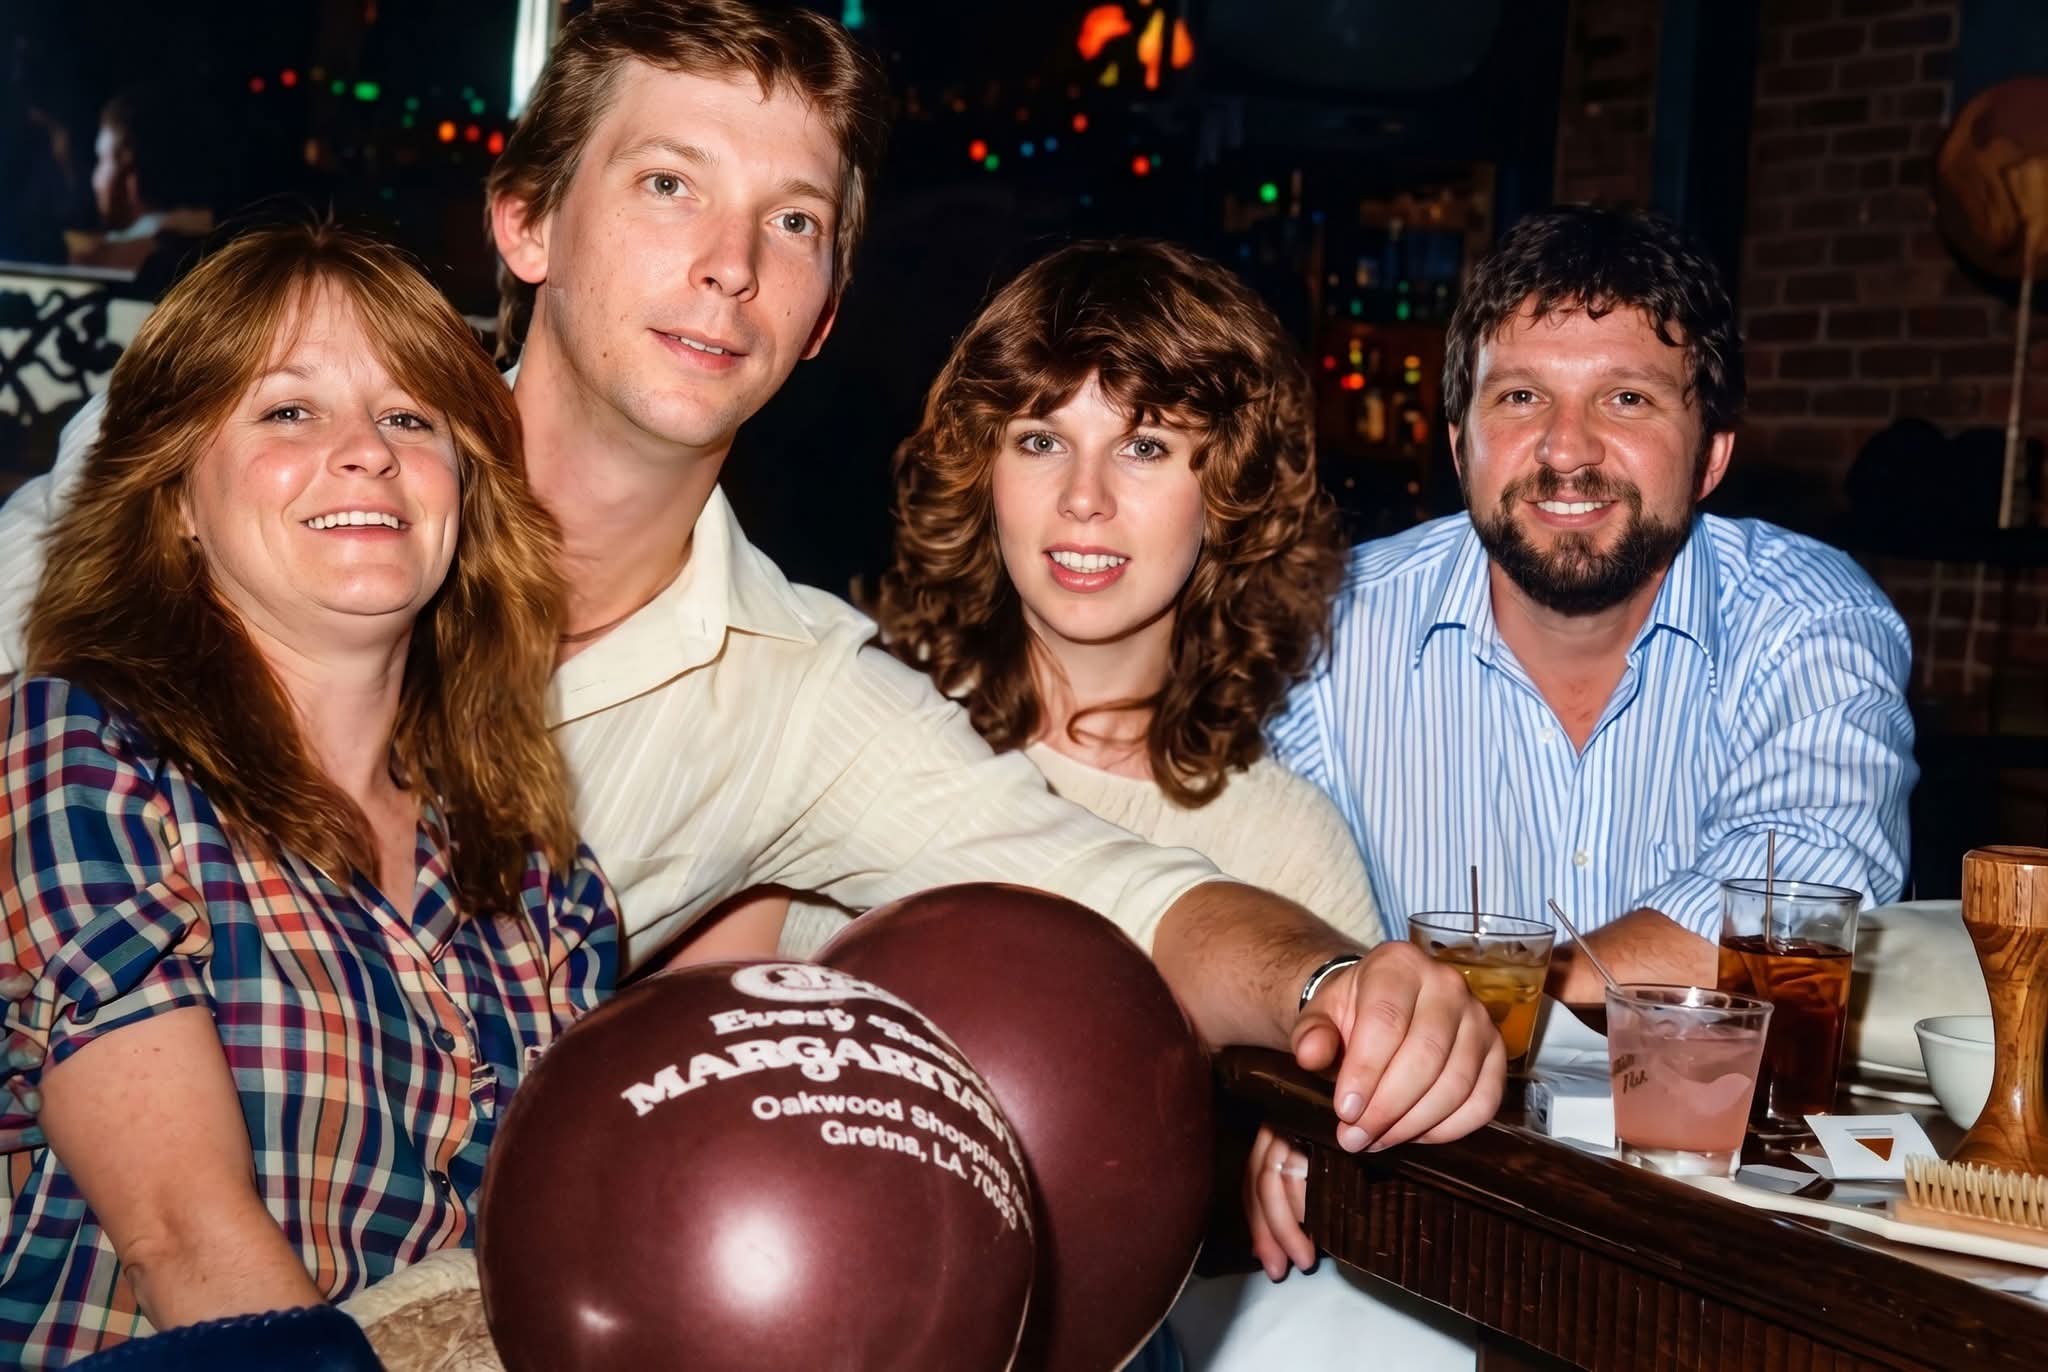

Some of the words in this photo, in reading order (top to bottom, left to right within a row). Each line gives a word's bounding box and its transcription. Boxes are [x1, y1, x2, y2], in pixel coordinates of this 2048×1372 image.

[709, 1008, 856, 1035] Every
[751, 1091, 905, 1121] Oakwood
[910, 1105, 1010, 1194] Shopping
[820, 1119, 928, 1163] Gretna,
[970, 1164, 1018, 1231] 70053
